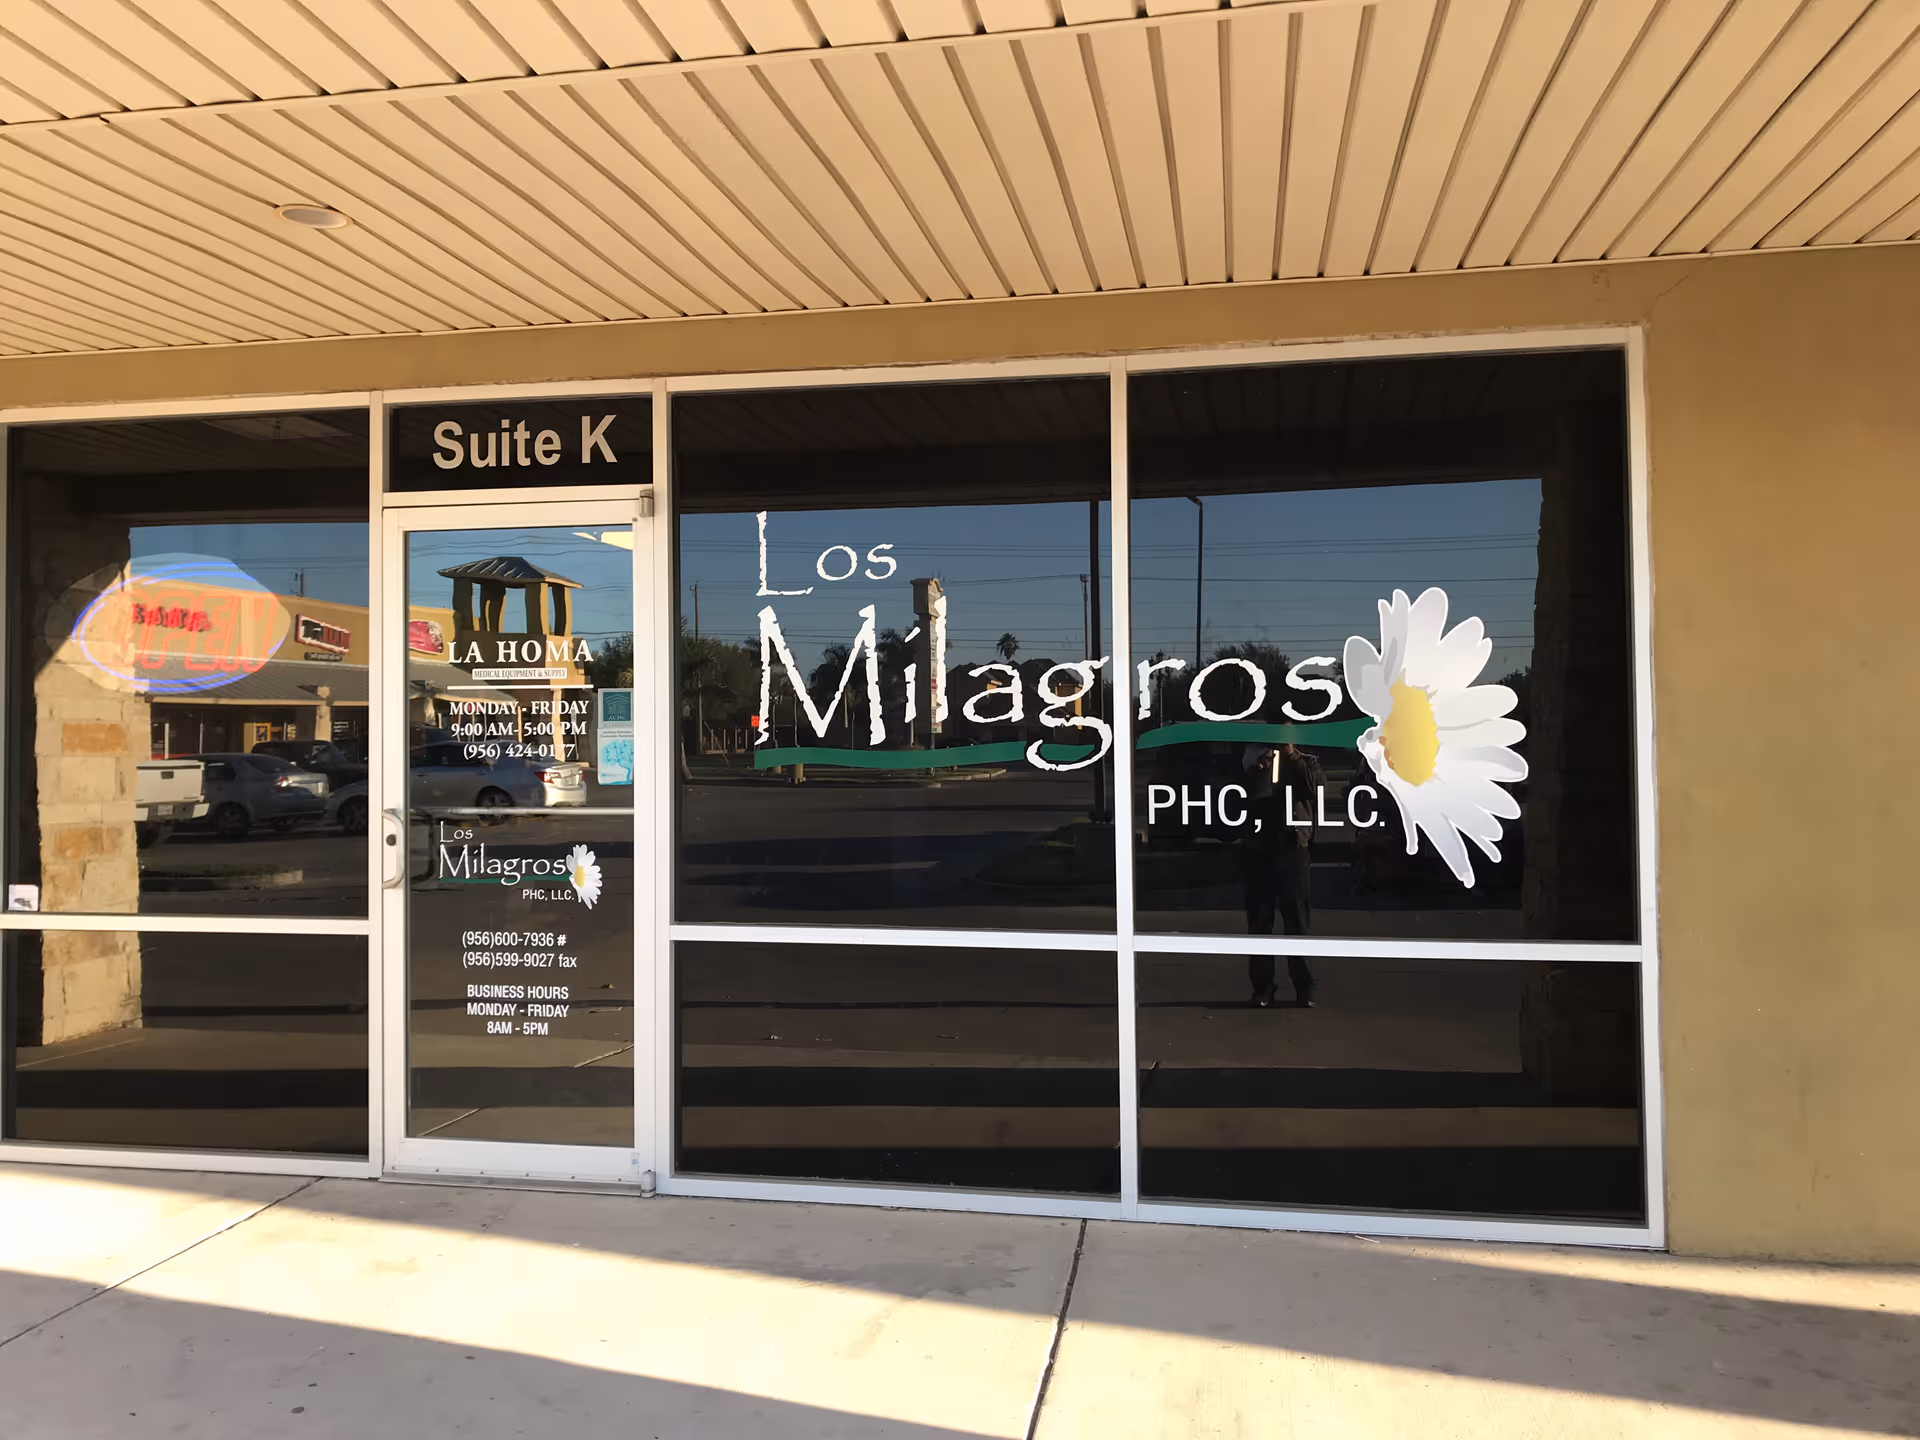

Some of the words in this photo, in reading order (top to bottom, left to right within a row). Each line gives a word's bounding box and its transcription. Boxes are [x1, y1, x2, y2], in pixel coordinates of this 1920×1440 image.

[432, 419, 562, 469] Suite
[580, 414, 618, 464] K
[755, 510, 897, 597] Los
[447, 641, 484, 664] LA
[496, 639, 594, 663] HOMA
[474, 670, 501, 678] MEDICAL
[502, 669, 537, 679] EQUIPMENT
[538, 670, 543, 678] &
[544, 669, 567, 678] SUPPLY
[754, 595, 1344, 771] Milagros
[449, 701, 519, 716] MONDAY
[531, 700, 590, 715] FRIDAY
[451, 723, 483, 737] 9:00
[523, 722, 555, 736] 5:00
[561, 721, 587, 735] PM
[463, 743, 501, 760] (956)
[505, 743, 576, 758] 424-0177
[1147, 784, 1262, 833] PHC,
[1285, 784, 1386, 828] LLC.
[439, 820, 474, 843] Los
[438, 842, 567, 886] Milagros
[522, 889, 548, 901] PHC,
[551, 889, 575, 900] LLC.
[462, 931, 554, 949] (956)600-7936
[556, 934, 567, 947] #
[462, 951, 555, 969] (956)599-9027
[558, 953, 577, 968] fax
[467, 984, 524, 999] BUSINESS
[527, 986, 569, 1000] HOURS
[466, 1002, 517, 1016] MONDAY
[527, 1004, 570, 1018] FRIDAY
[486, 1021, 512, 1034] 8AM
[522, 1022, 549, 1036] 5PM
